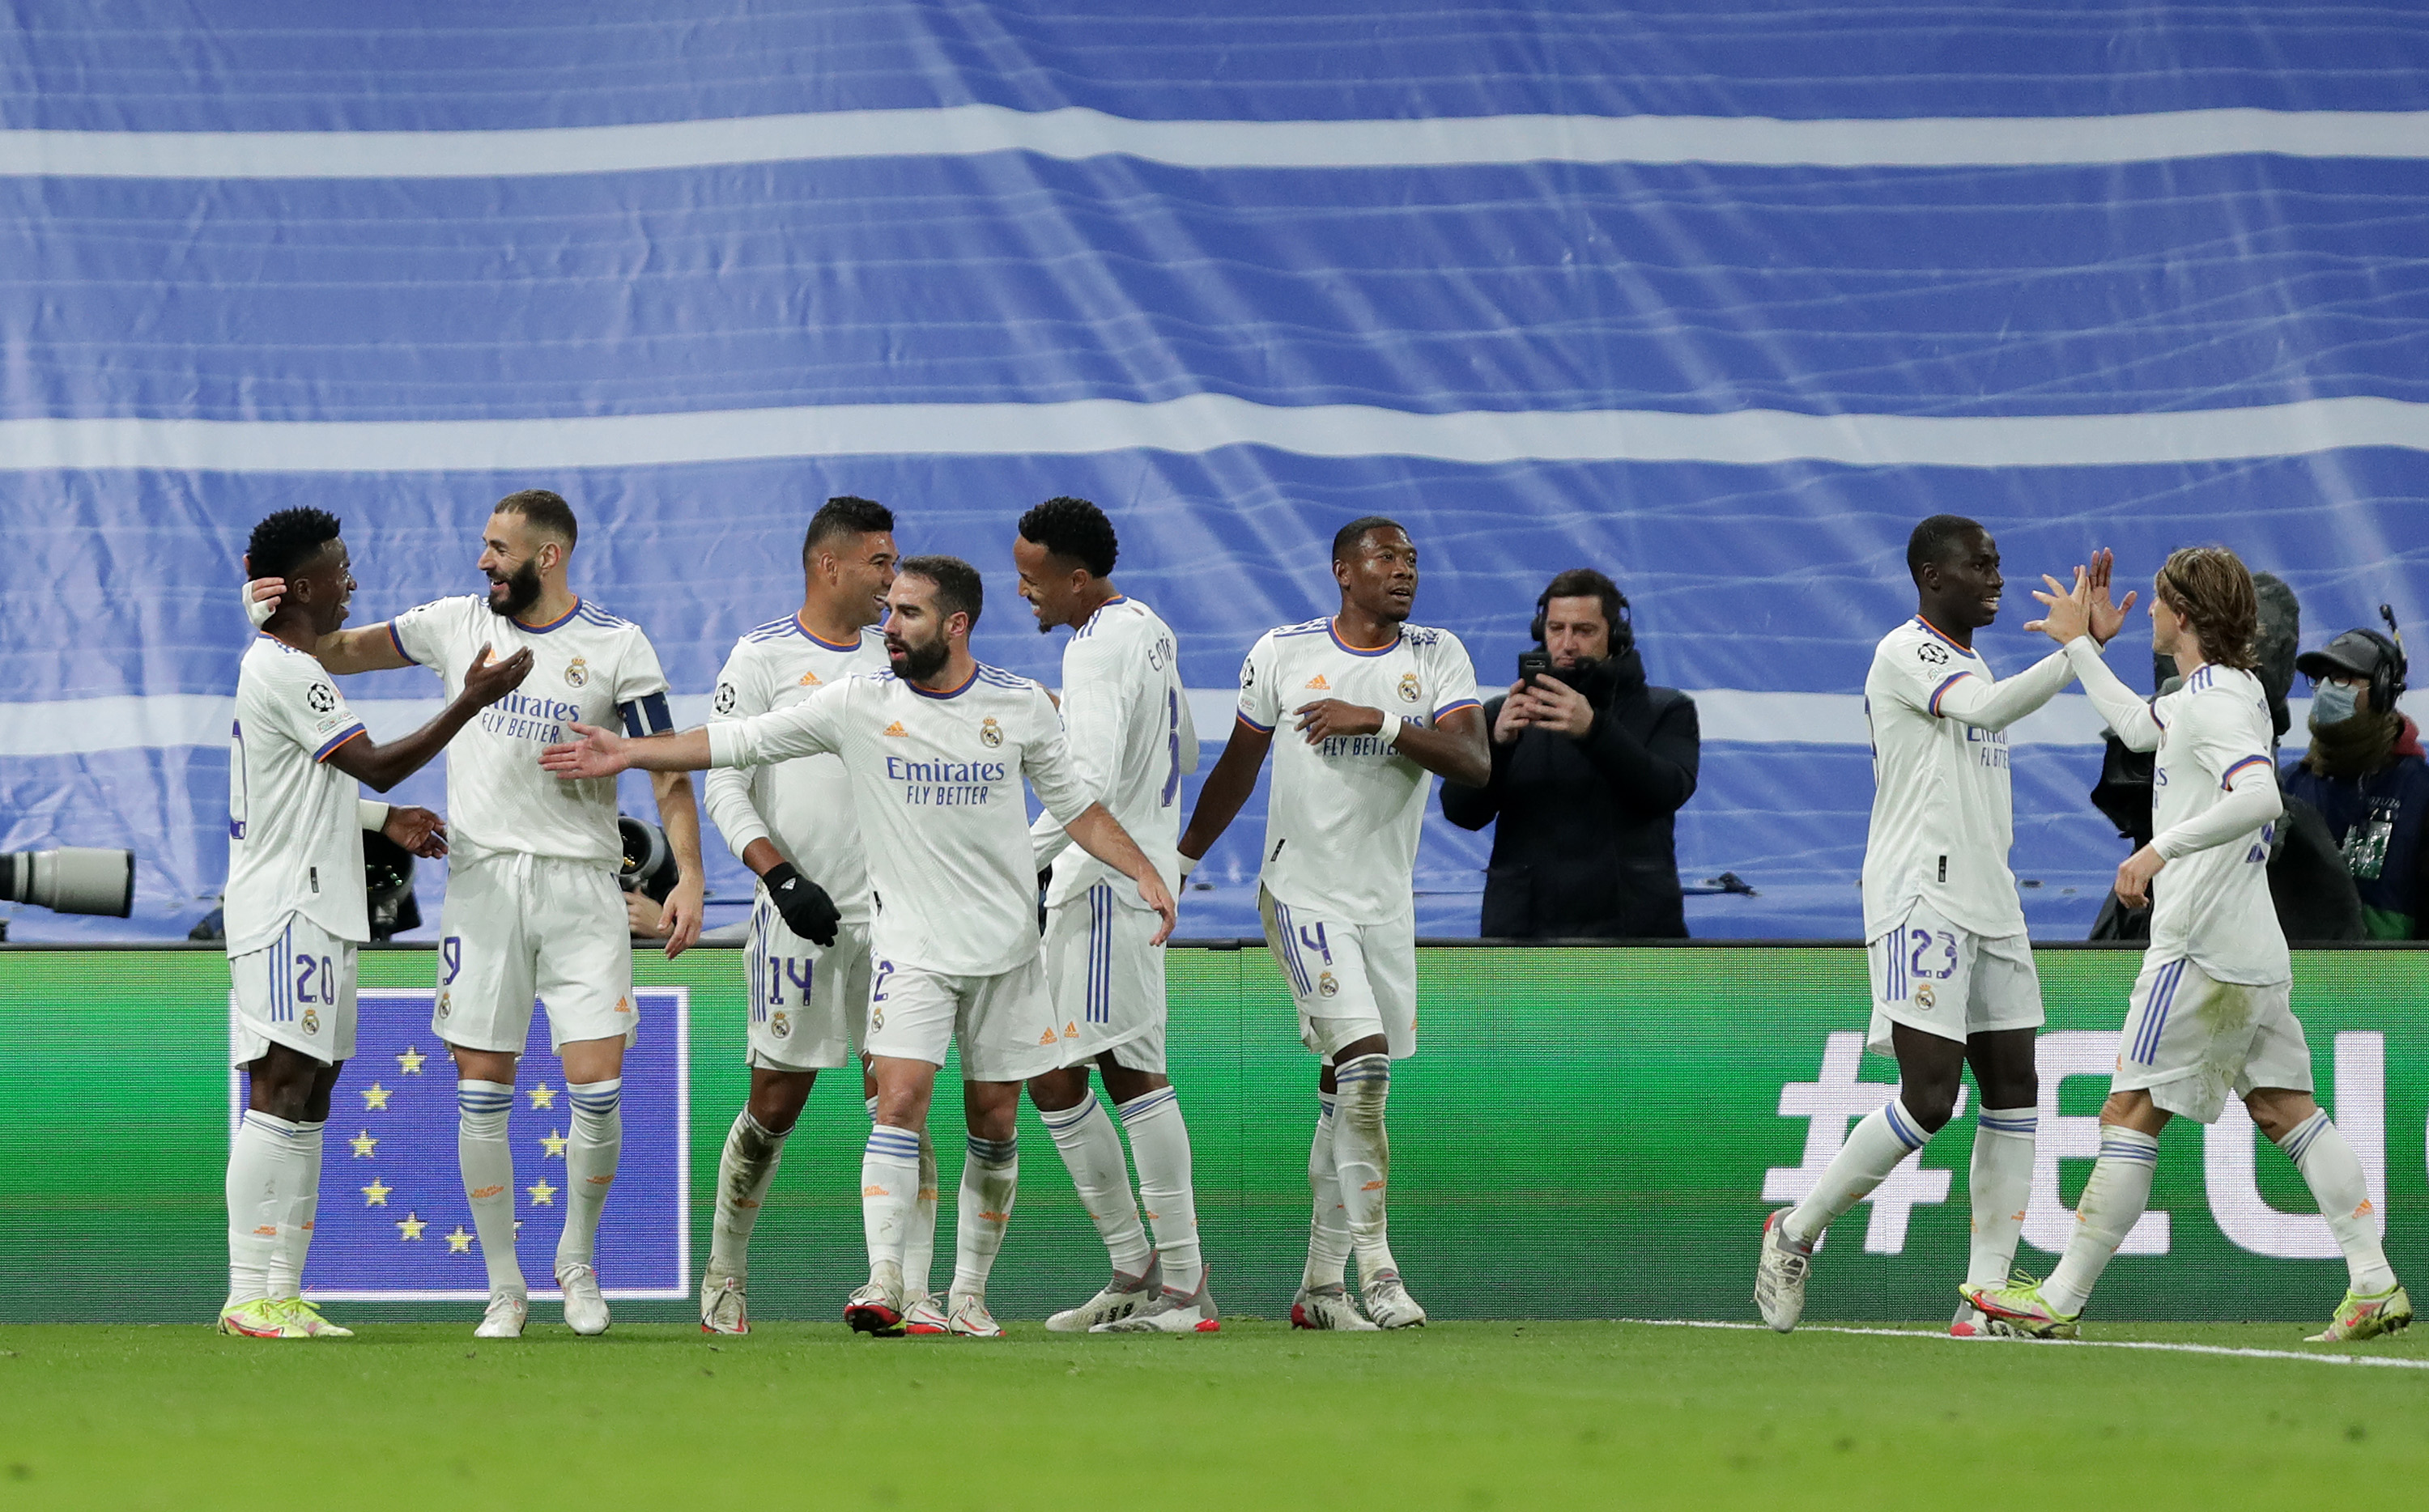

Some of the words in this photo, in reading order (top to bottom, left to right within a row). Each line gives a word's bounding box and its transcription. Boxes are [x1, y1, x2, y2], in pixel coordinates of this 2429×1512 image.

[483, 713, 505, 733] FLY
[507, 717, 560, 744] BETTER
[1323, 737, 1347, 756] FLY
[886, 757, 1005, 782] Emirates
[907, 785, 930, 805] FLY
[936, 786, 989, 805] BETTER
[443, 937, 461, 985] 9
[1300, 921, 1333, 966] 4
[1911, 928, 1958, 979] 23
[296, 954, 334, 1005] 20
[769, 957, 813, 1006] 14
[874, 960, 895, 1002] 2
